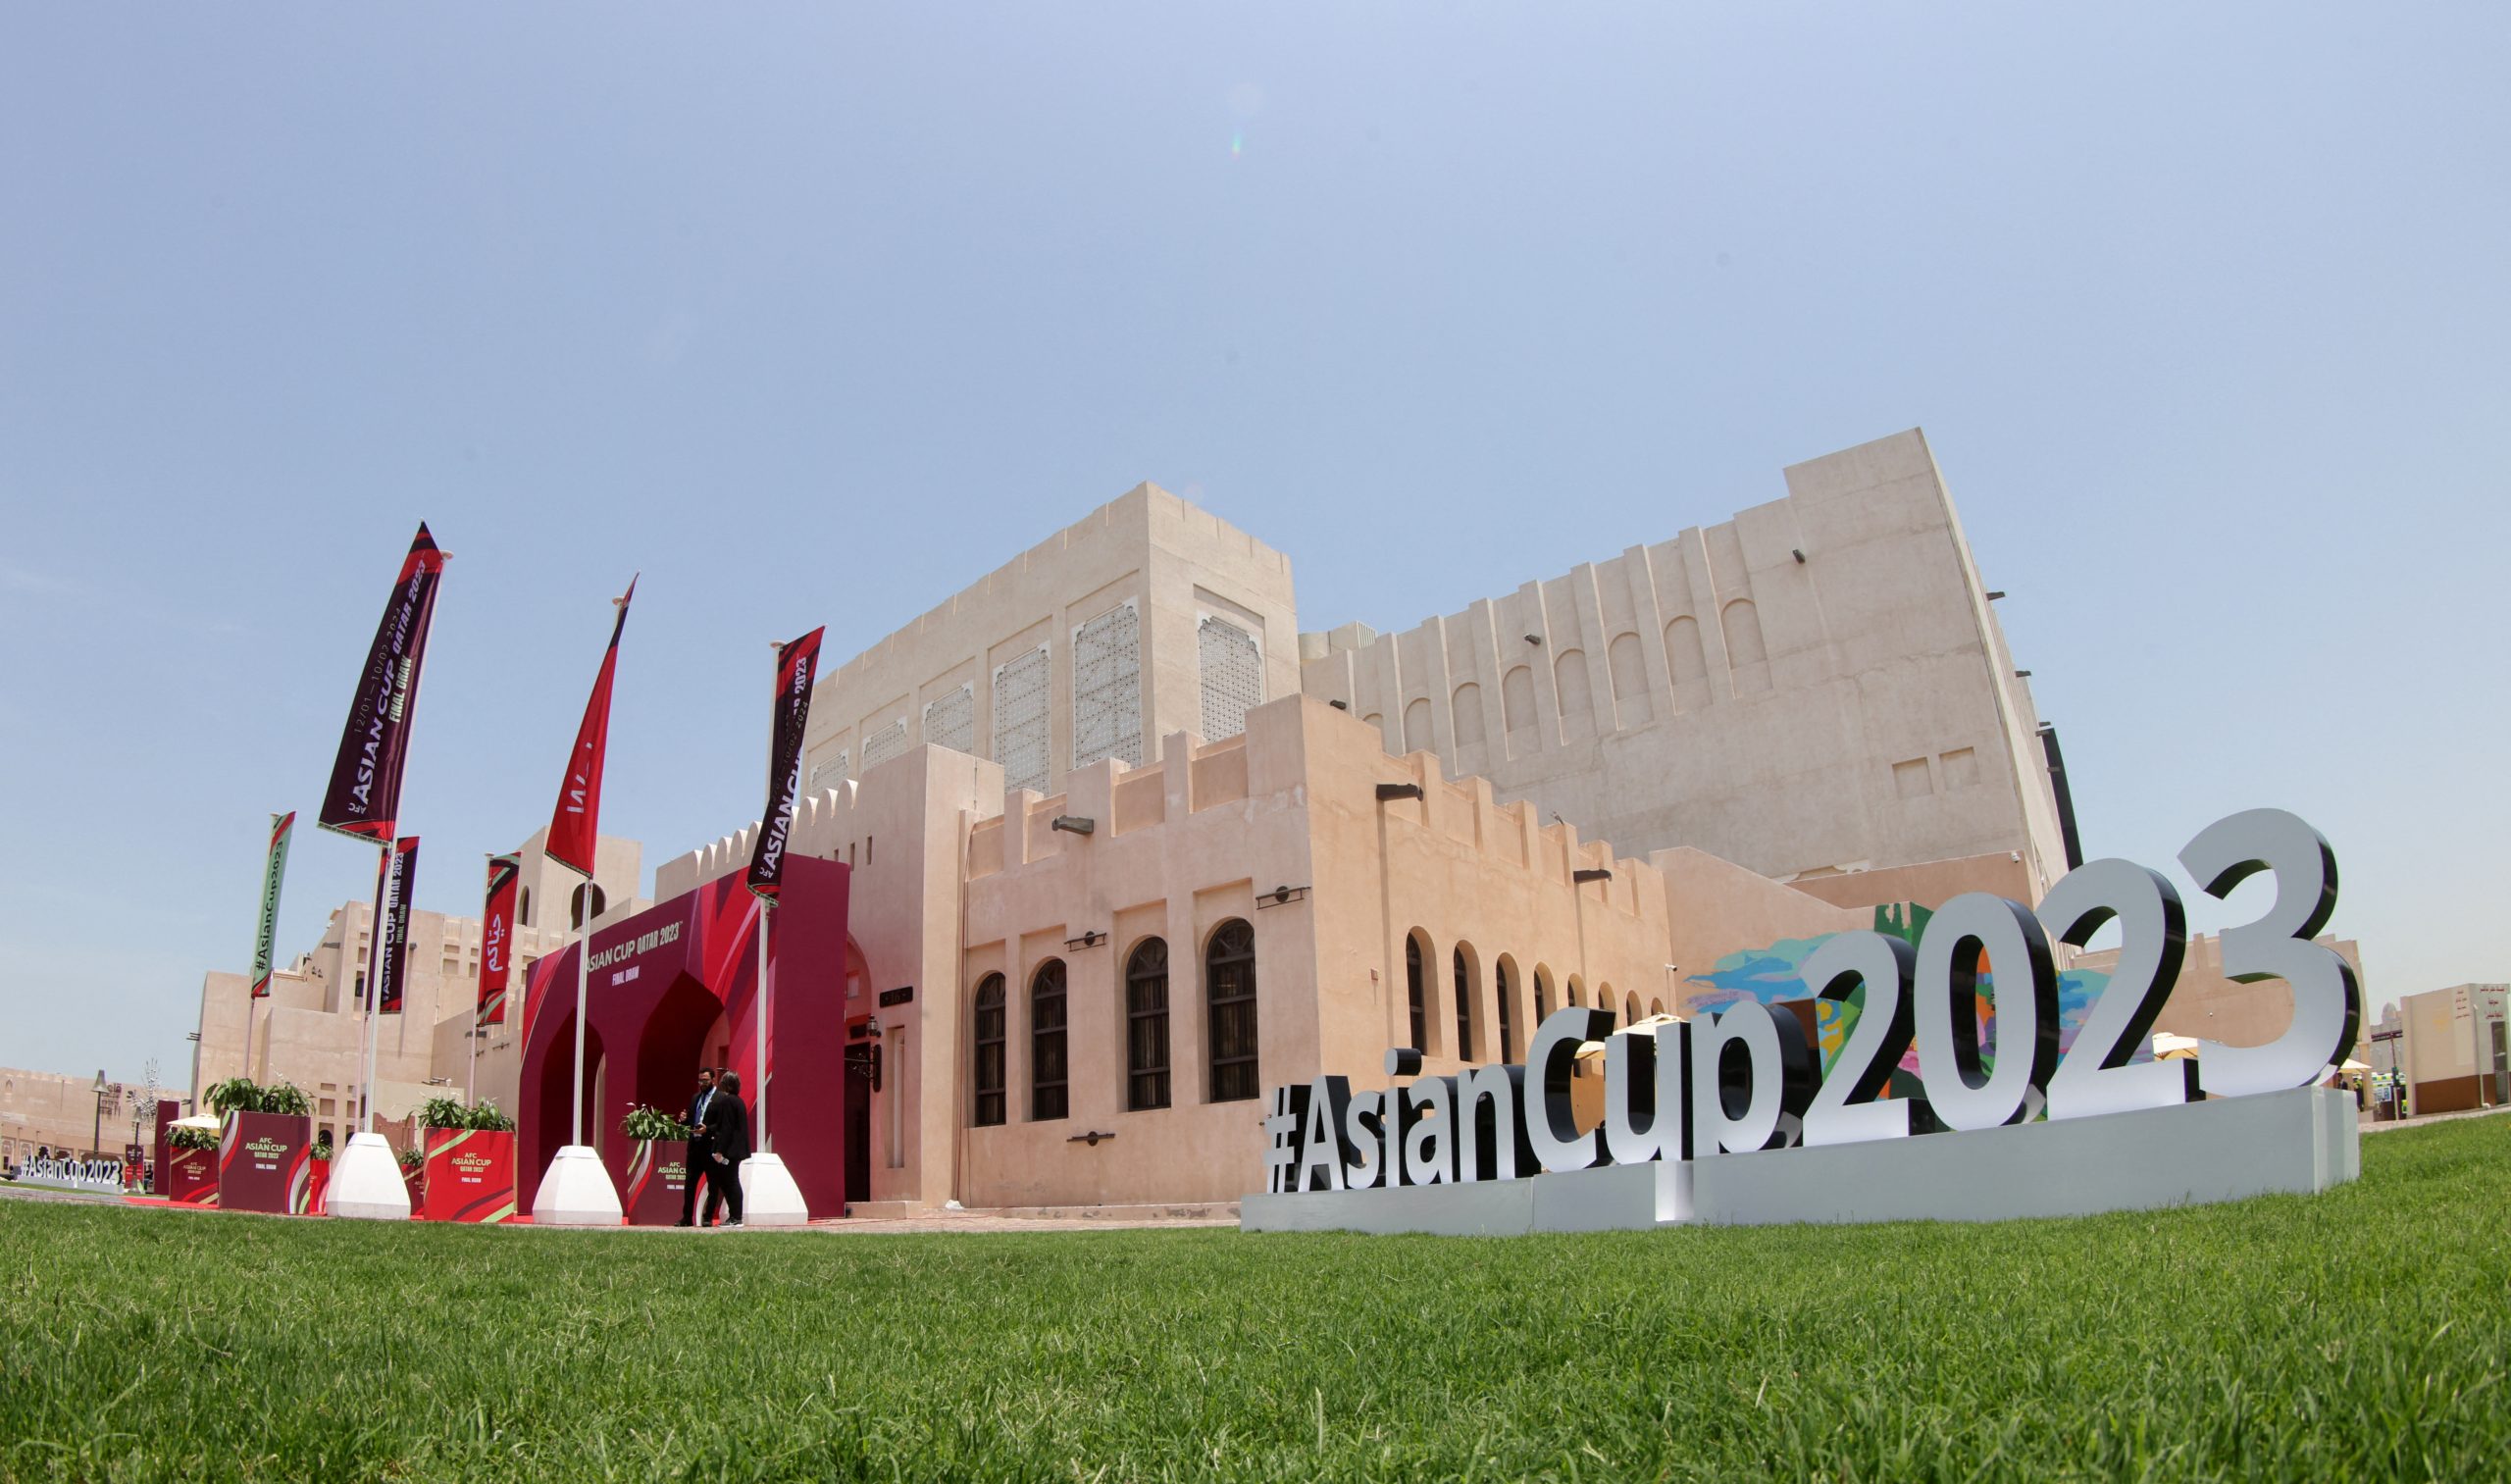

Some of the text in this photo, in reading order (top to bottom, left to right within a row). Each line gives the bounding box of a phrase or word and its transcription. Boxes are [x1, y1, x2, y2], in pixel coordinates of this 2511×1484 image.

[352, 717, 384, 805] ASIAN
[377, 658, 394, 715] CUP
[392, 601, 412, 655] QATAR
[388, 654, 412, 723] FINAL DRAW
[348, 802, 367, 815] AFC
[762, 794, 793, 870] ASIAN
[392, 851, 405, 877] 2023
[759, 866, 774, 879] AFC
[255, 841, 283, 972] #AsianCup2023
[389, 878, 400, 908] QATAR
[385, 912, 396, 946] CUP
[613, 940, 636, 962] CUP
[637, 930, 659, 954] QATAR
[383, 947, 392, 994] ASIAN
[611, 971, 625, 987] FINAL
[1263, 808, 2360, 1199] #AsianCup2023
[271, 1144, 287, 1152] CUP
[20, 1155, 122, 1186] #AsianCup2023
